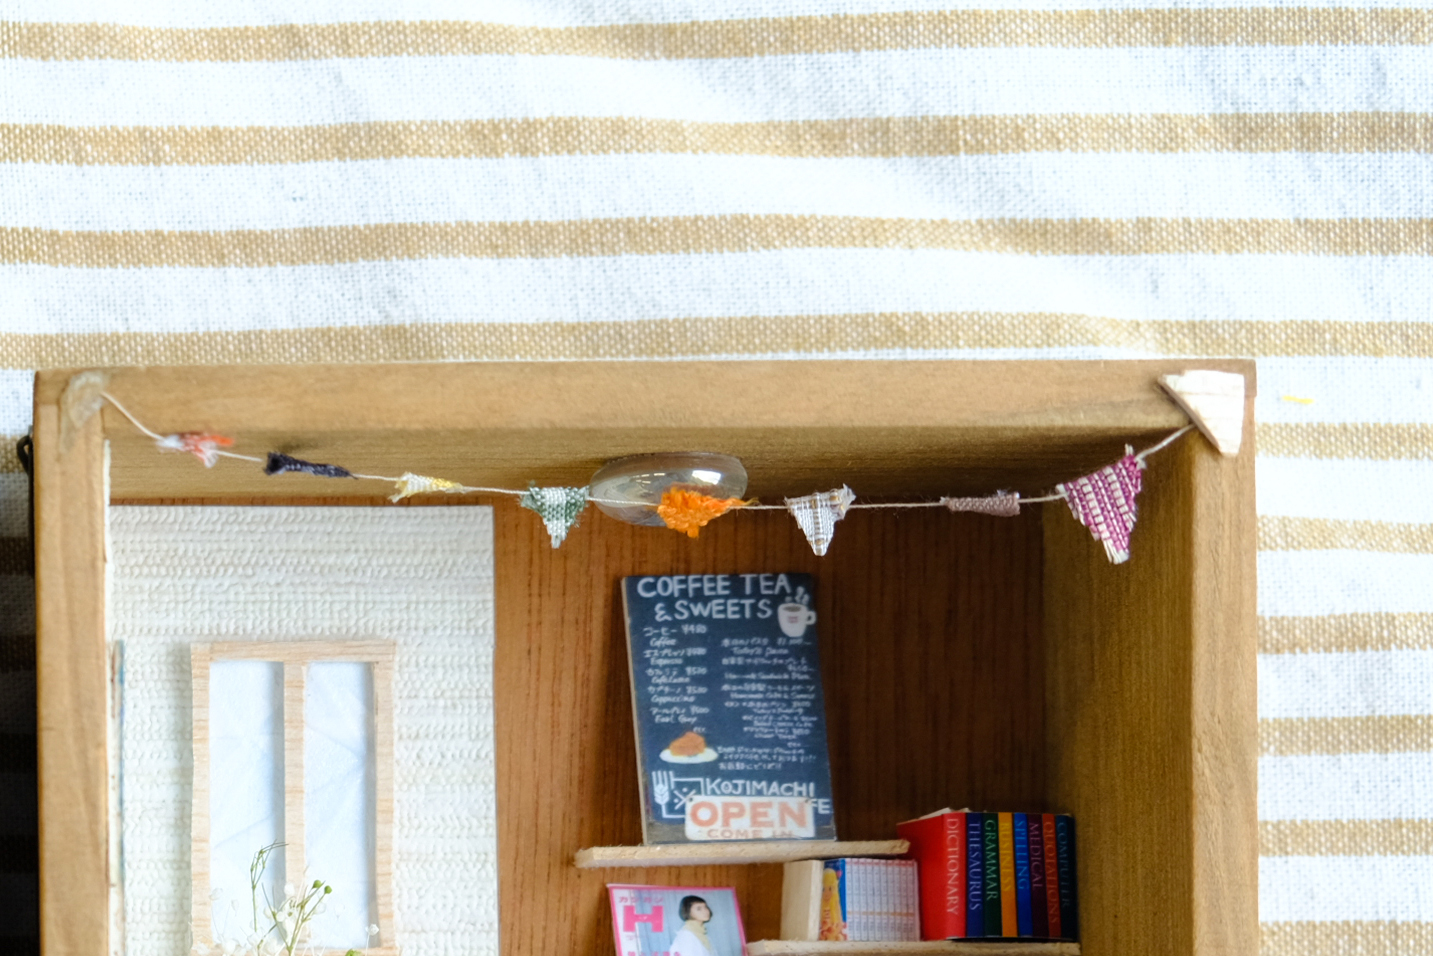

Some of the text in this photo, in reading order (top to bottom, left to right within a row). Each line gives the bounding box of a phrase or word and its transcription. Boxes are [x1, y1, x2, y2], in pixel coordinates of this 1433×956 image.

[637, 573, 791, 598] COFFEE TEA
[654, 599, 773, 622] & SWEETS
[689, 801, 808, 828] OPEN
[705, 777, 815, 798] KOJIMACHI
[707, 828, 763, 839] COME
[946, 818, 959, 915] DICTIONARY
[968, 822, 982, 911] THESAURUS
[984, 819, 999, 901] GRAMMAR
[999, 822, 1012, 892] BUSINESS
[1014, 820, 1030, 890] SPELLING
[1029, 822, 1043, 888] MEDICAL
[1043, 821, 1059, 923] QUOTATIONS
